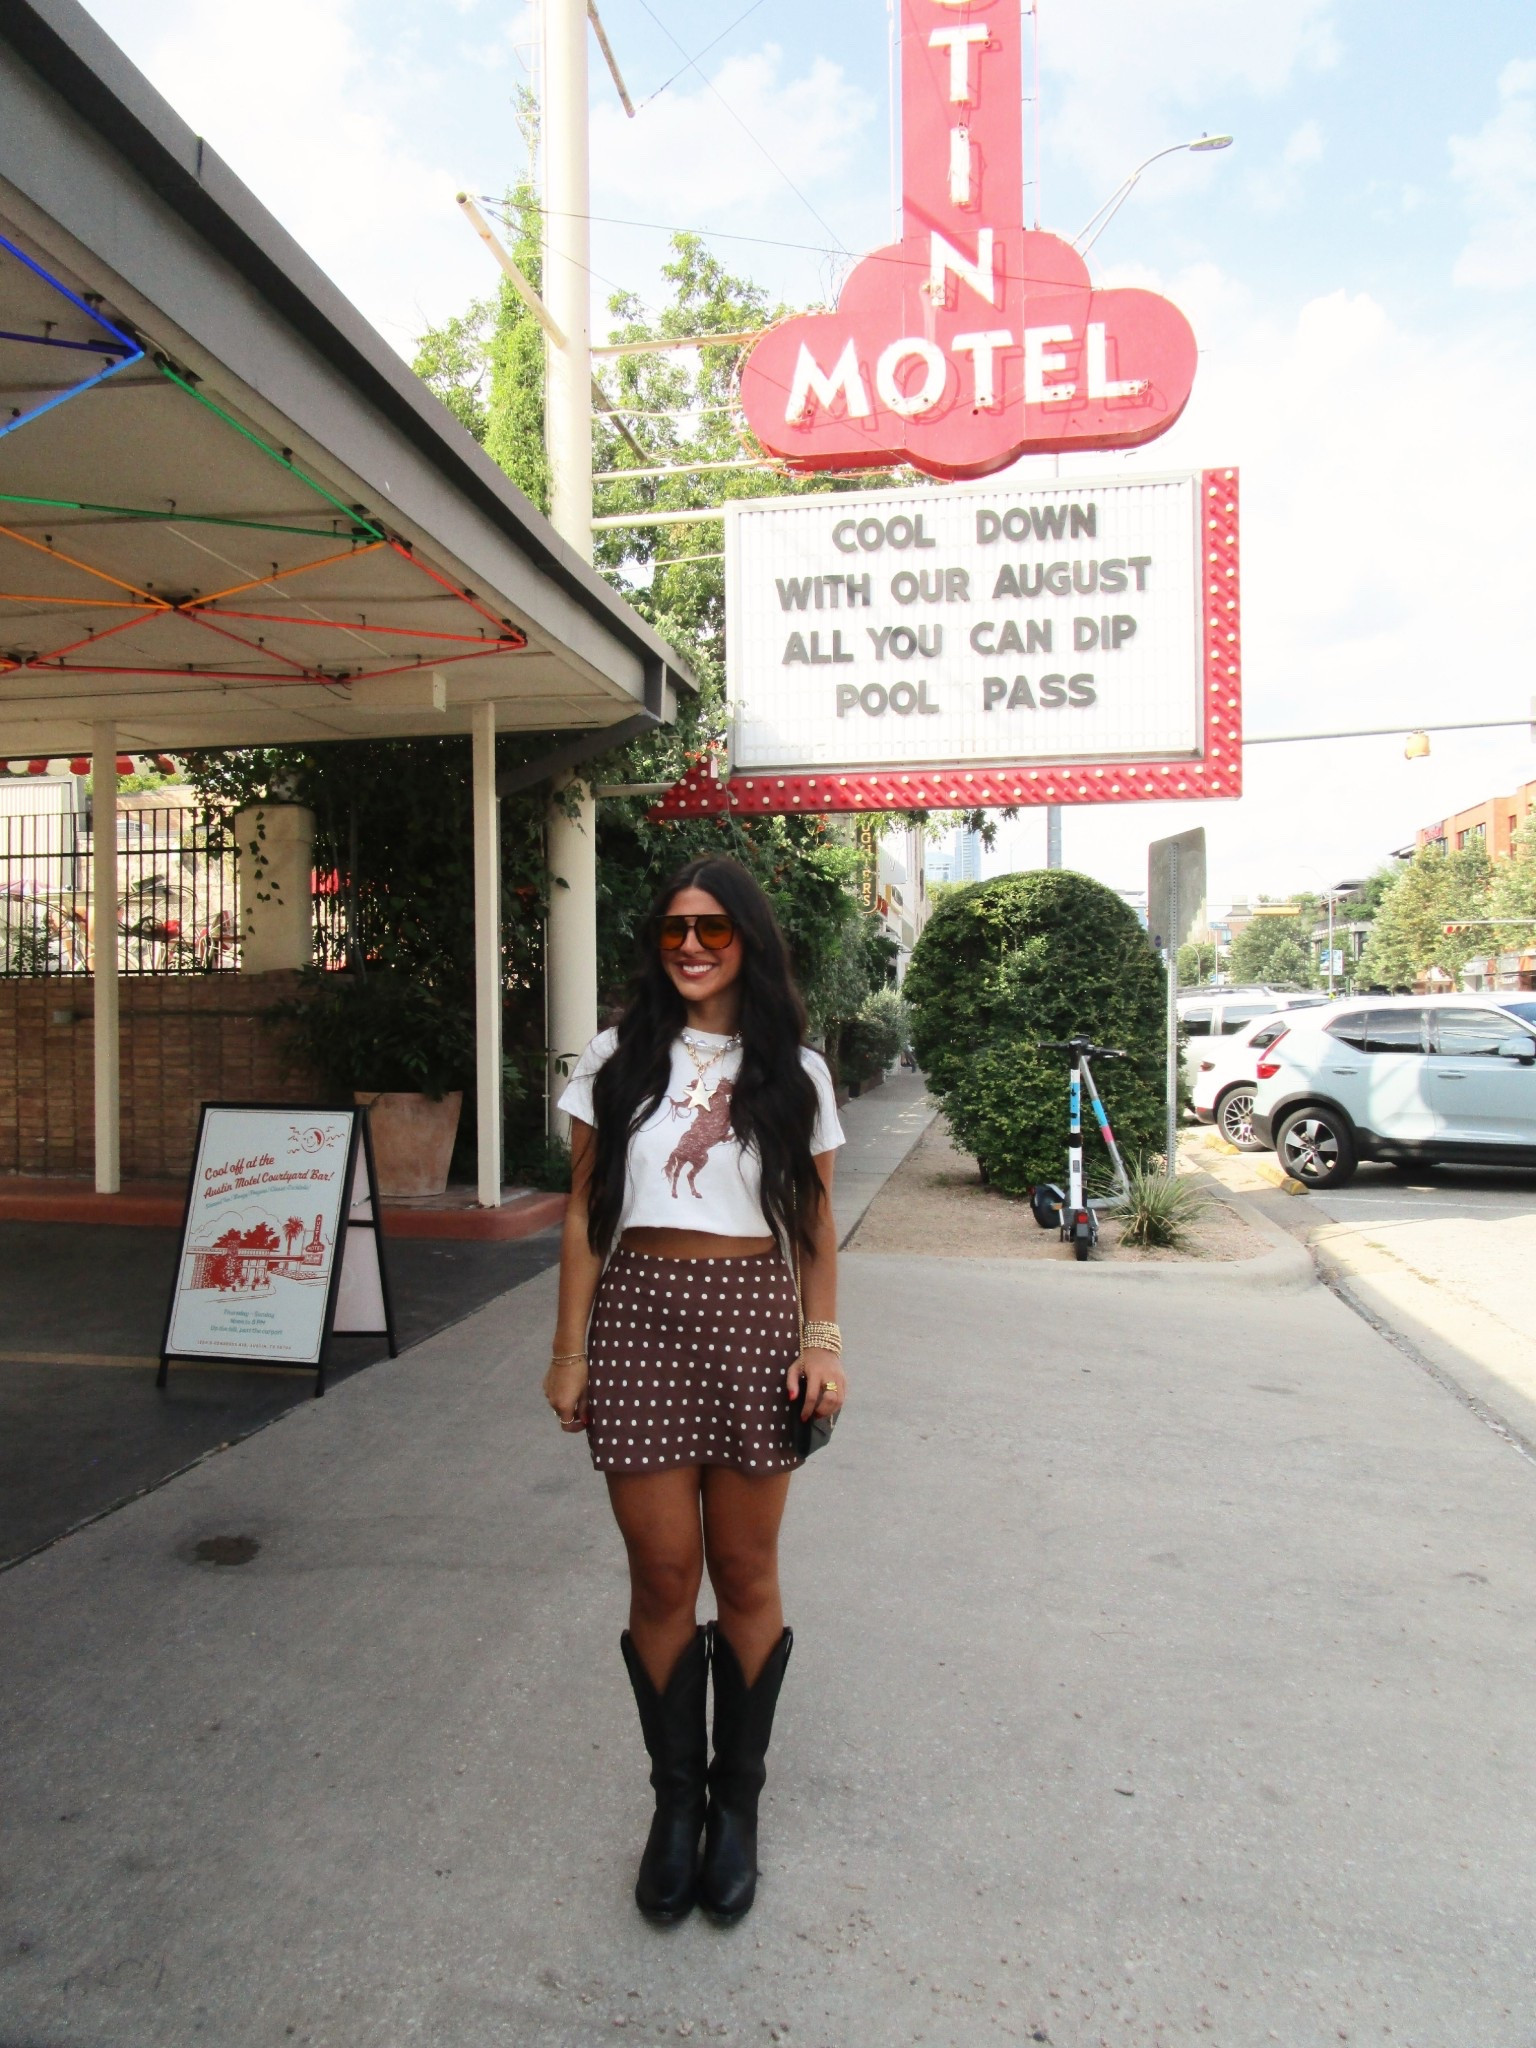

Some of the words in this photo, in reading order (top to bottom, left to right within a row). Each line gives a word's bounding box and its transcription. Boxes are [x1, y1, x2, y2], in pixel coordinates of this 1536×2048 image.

[928, 0, 995, 306] TIN
[784, 322, 1146, 427] MOTEL
[832, 514, 935, 554] COOL
[976, 503, 1097, 544] DOWN
[775, 573, 871, 611] WITH
[891, 567, 970, 604] OUR
[992, 556, 1152, 599] AUGUST
[782, 630, 853, 665] ALL
[867, 624, 943, 660] YOU
[970, 619, 1052, 655] CAN
[1073, 614, 1137, 652] DIP
[836, 680, 939, 717] POOL
[983, 673, 1097, 711] PASS
[204, 1183, 233, 1199] Austin
[235, 1173, 260, 1189] Motel
[262, 1169, 309, 1183] Courtyard
[310, 1168, 335, 1181] Bar!
[205, 1162, 229, 1180] Cool
[230, 1158, 244, 1175] off
[246, 1156, 257, 1169] at
[258, 1153, 275, 1166] the
